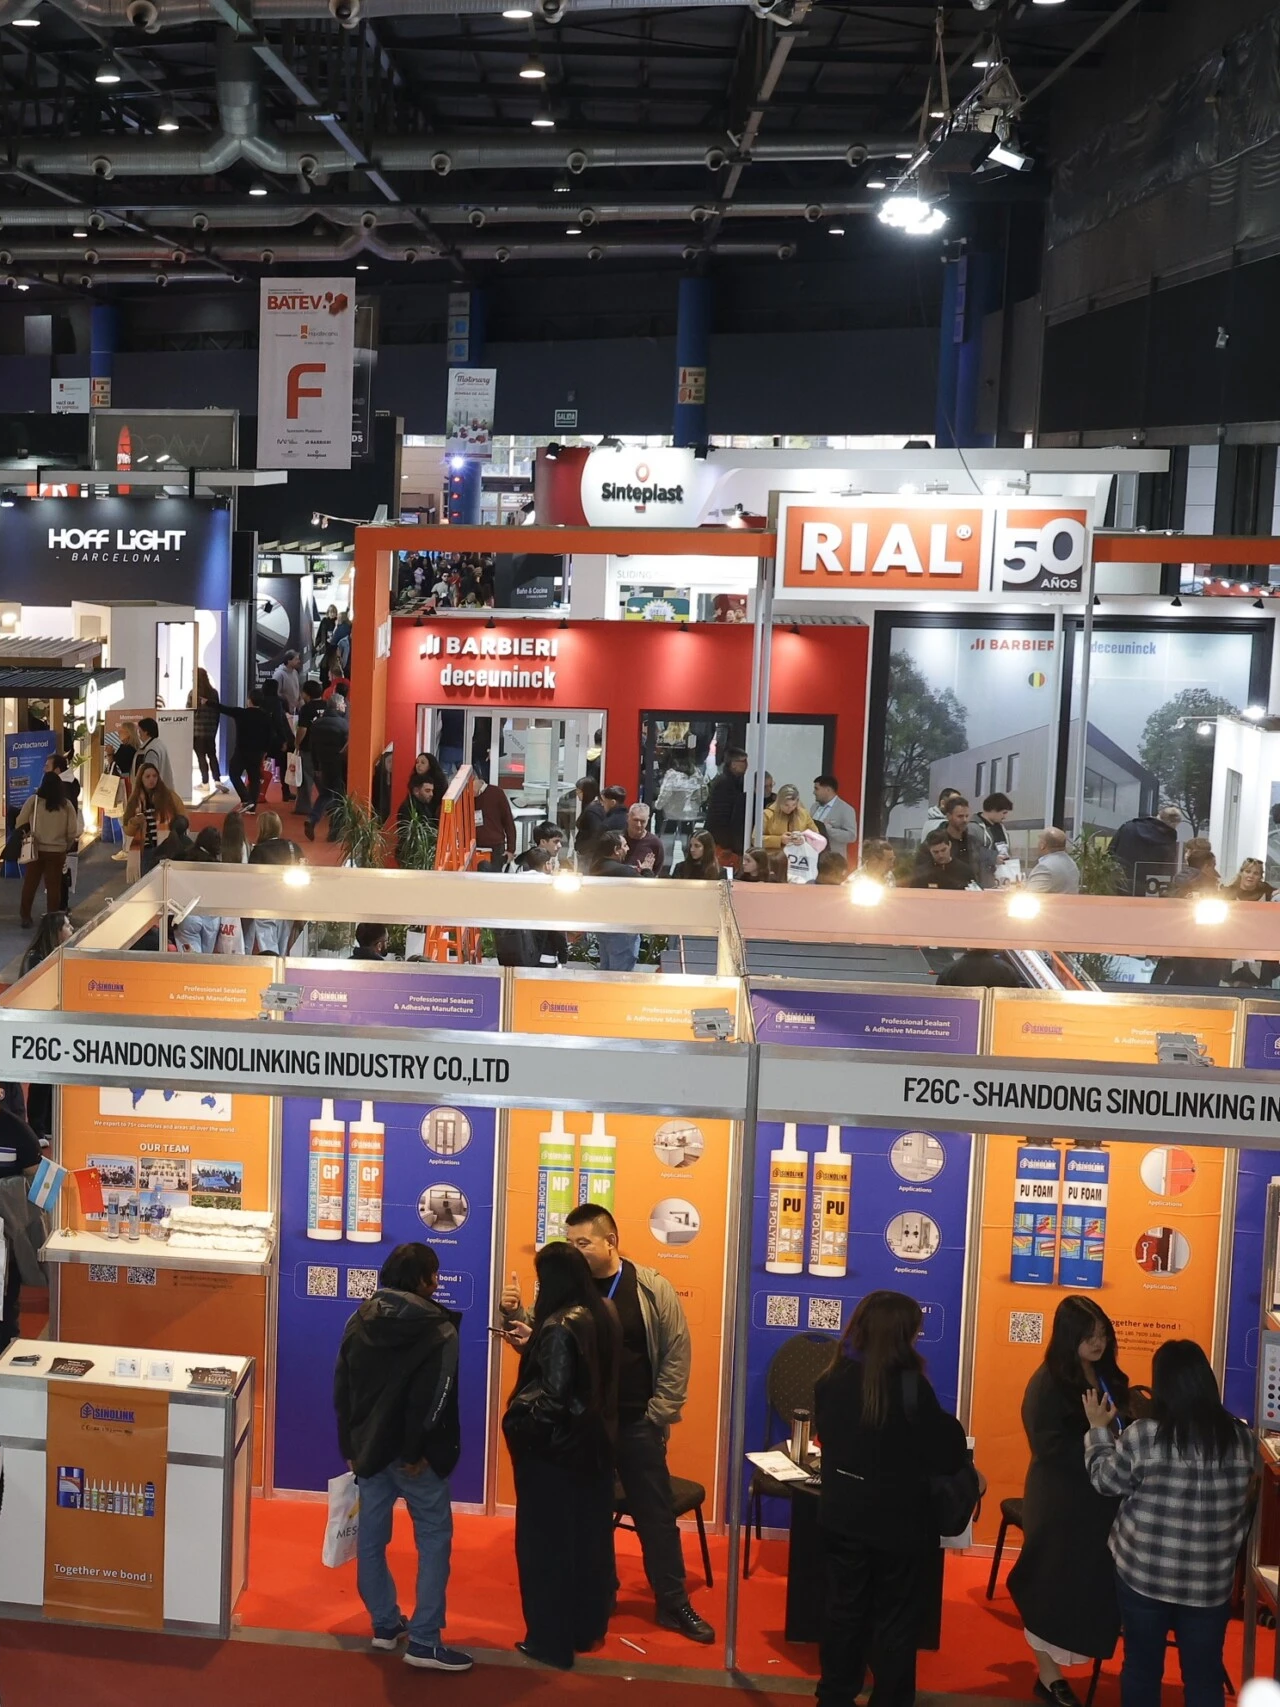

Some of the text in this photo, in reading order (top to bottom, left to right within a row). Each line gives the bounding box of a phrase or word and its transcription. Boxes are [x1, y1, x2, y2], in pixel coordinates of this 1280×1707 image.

[286, 363, 326, 419] F
[601, 482, 684, 505] Sinteplast
[800, 521, 964, 576] RIAL
[1002, 517, 1084, 584] 50
[71, 551, 162, 563] BARCELONA
[1040, 576, 1078, 590] AÑOS
[446, 636, 559, 657] BARBIERI
[989, 639, 1157, 655] BARBIER deceuninck
[440, 663, 556, 689] deceuninck
[183, 985, 222, 993] Professional
[206, 995, 247, 1003] Manufacture
[409, 995, 474, 1005] Professional Sealant
[400, 1003, 430, 1011] Adhesive
[431, 1004, 474, 1014] Manufacture
[664, 1016, 693, 1024] Manufa
[881, 1017, 951, 1028] Professional Sealant
[872, 1025, 903, 1034] Adhesive
[904, 1027, 950, 1037] Manufacture
[11, 1035, 62, 1061] F26C
[72, 1038, 186, 1069] SHANDONG
[189, 1045, 320, 1076] SINOLINKING
[324, 1051, 430, 1080] INDUSTRY
[433, 1056, 510, 1086] CO.,LTD
[904, 1077, 961, 1104] F26C
[972, 1080, 1102, 1114] SHANDONG
[1105, 1087, 1255, 1121] SINOLINKING
[139, 1142, 191, 1153] OUR TEAM
[428, 1158, 461, 1166] Applications
[322, 1164, 340, 1180] GP
[361, 1166, 380, 1182] GP
[660, 1171, 693, 1179] Applications
[552, 1175, 570, 1192] NP
[578, 1174, 588, 1207] SILICON
[593, 1178, 611, 1195] NP
[898, 1185, 932, 1194] Applications
[1019, 1184, 1054, 1199] PU FOAM
[1067, 1186, 1103, 1201] PU FOAM
[536, 1172, 547, 1243] SILICONE SEALANT
[782, 1197, 802, 1213] PU
[825, 1200, 845, 1216] PU
[1148, 1199, 1183, 1208] Applications
[767, 1192, 778, 1261] MS POLYMER
[810, 1194, 821, 1263] MS POLYMER
[426, 1237, 458, 1245] Applications
[657, 1252, 689, 1260] Applications
[439, 1274, 458, 1282] bond
[894, 1266, 928, 1275] Applications
[1142, 1283, 1178, 1291] Applications
[1110, 1319, 1141, 1329] ogether
[1156, 1322, 1177, 1330] bond
[94, 1408, 136, 1423] SINOLINK
[53, 1562, 101, 1578] Together
[102, 1568, 119, 1578] we
[120, 1568, 147, 1582] bond
